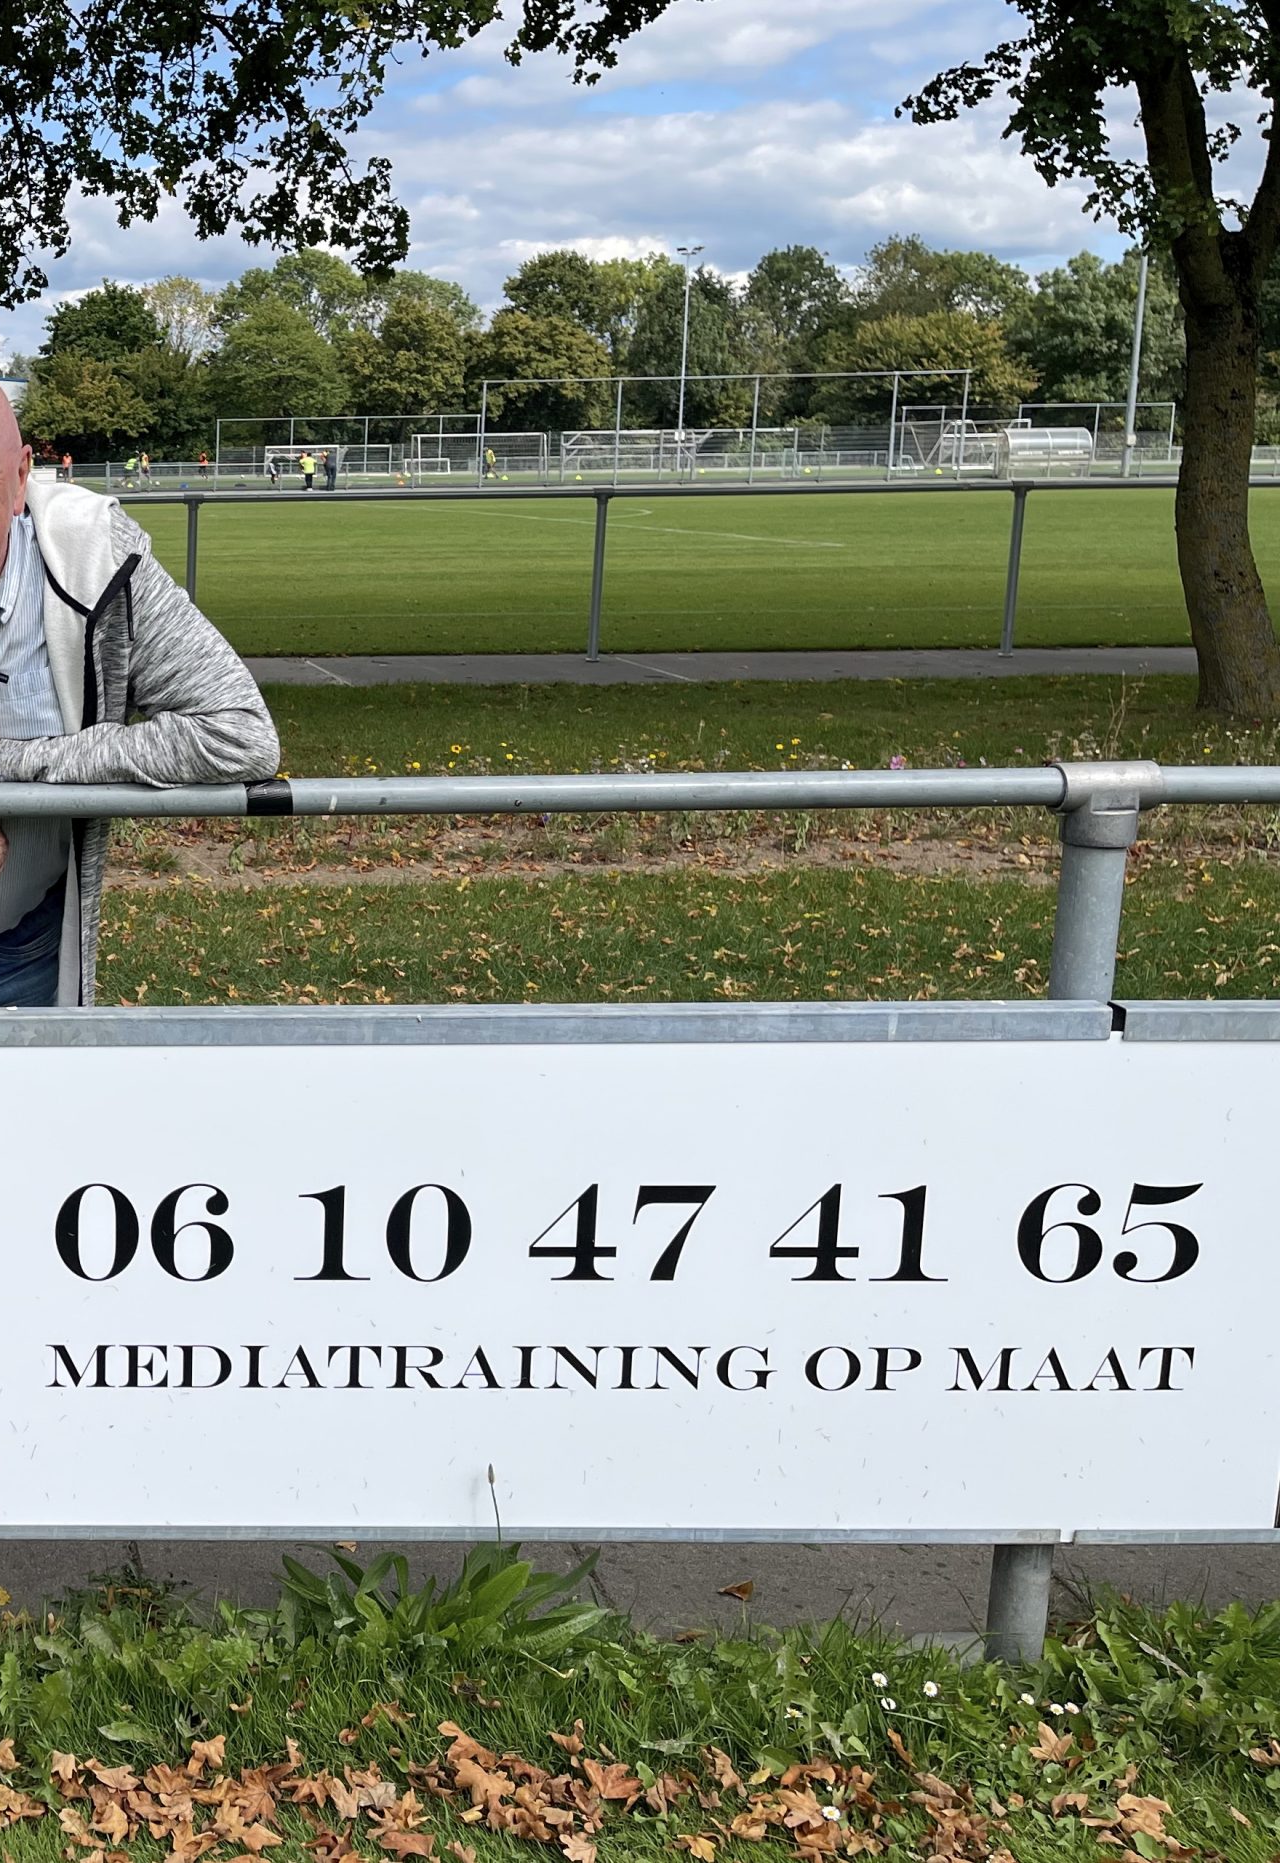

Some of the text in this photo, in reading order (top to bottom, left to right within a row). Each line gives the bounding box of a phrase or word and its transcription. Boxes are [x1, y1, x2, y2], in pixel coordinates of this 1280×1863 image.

[55, 1182, 1205, 1284] 06 10 47 41 65
[47, 1344, 1196, 1392] MEDIATRAINING OP MAAT
